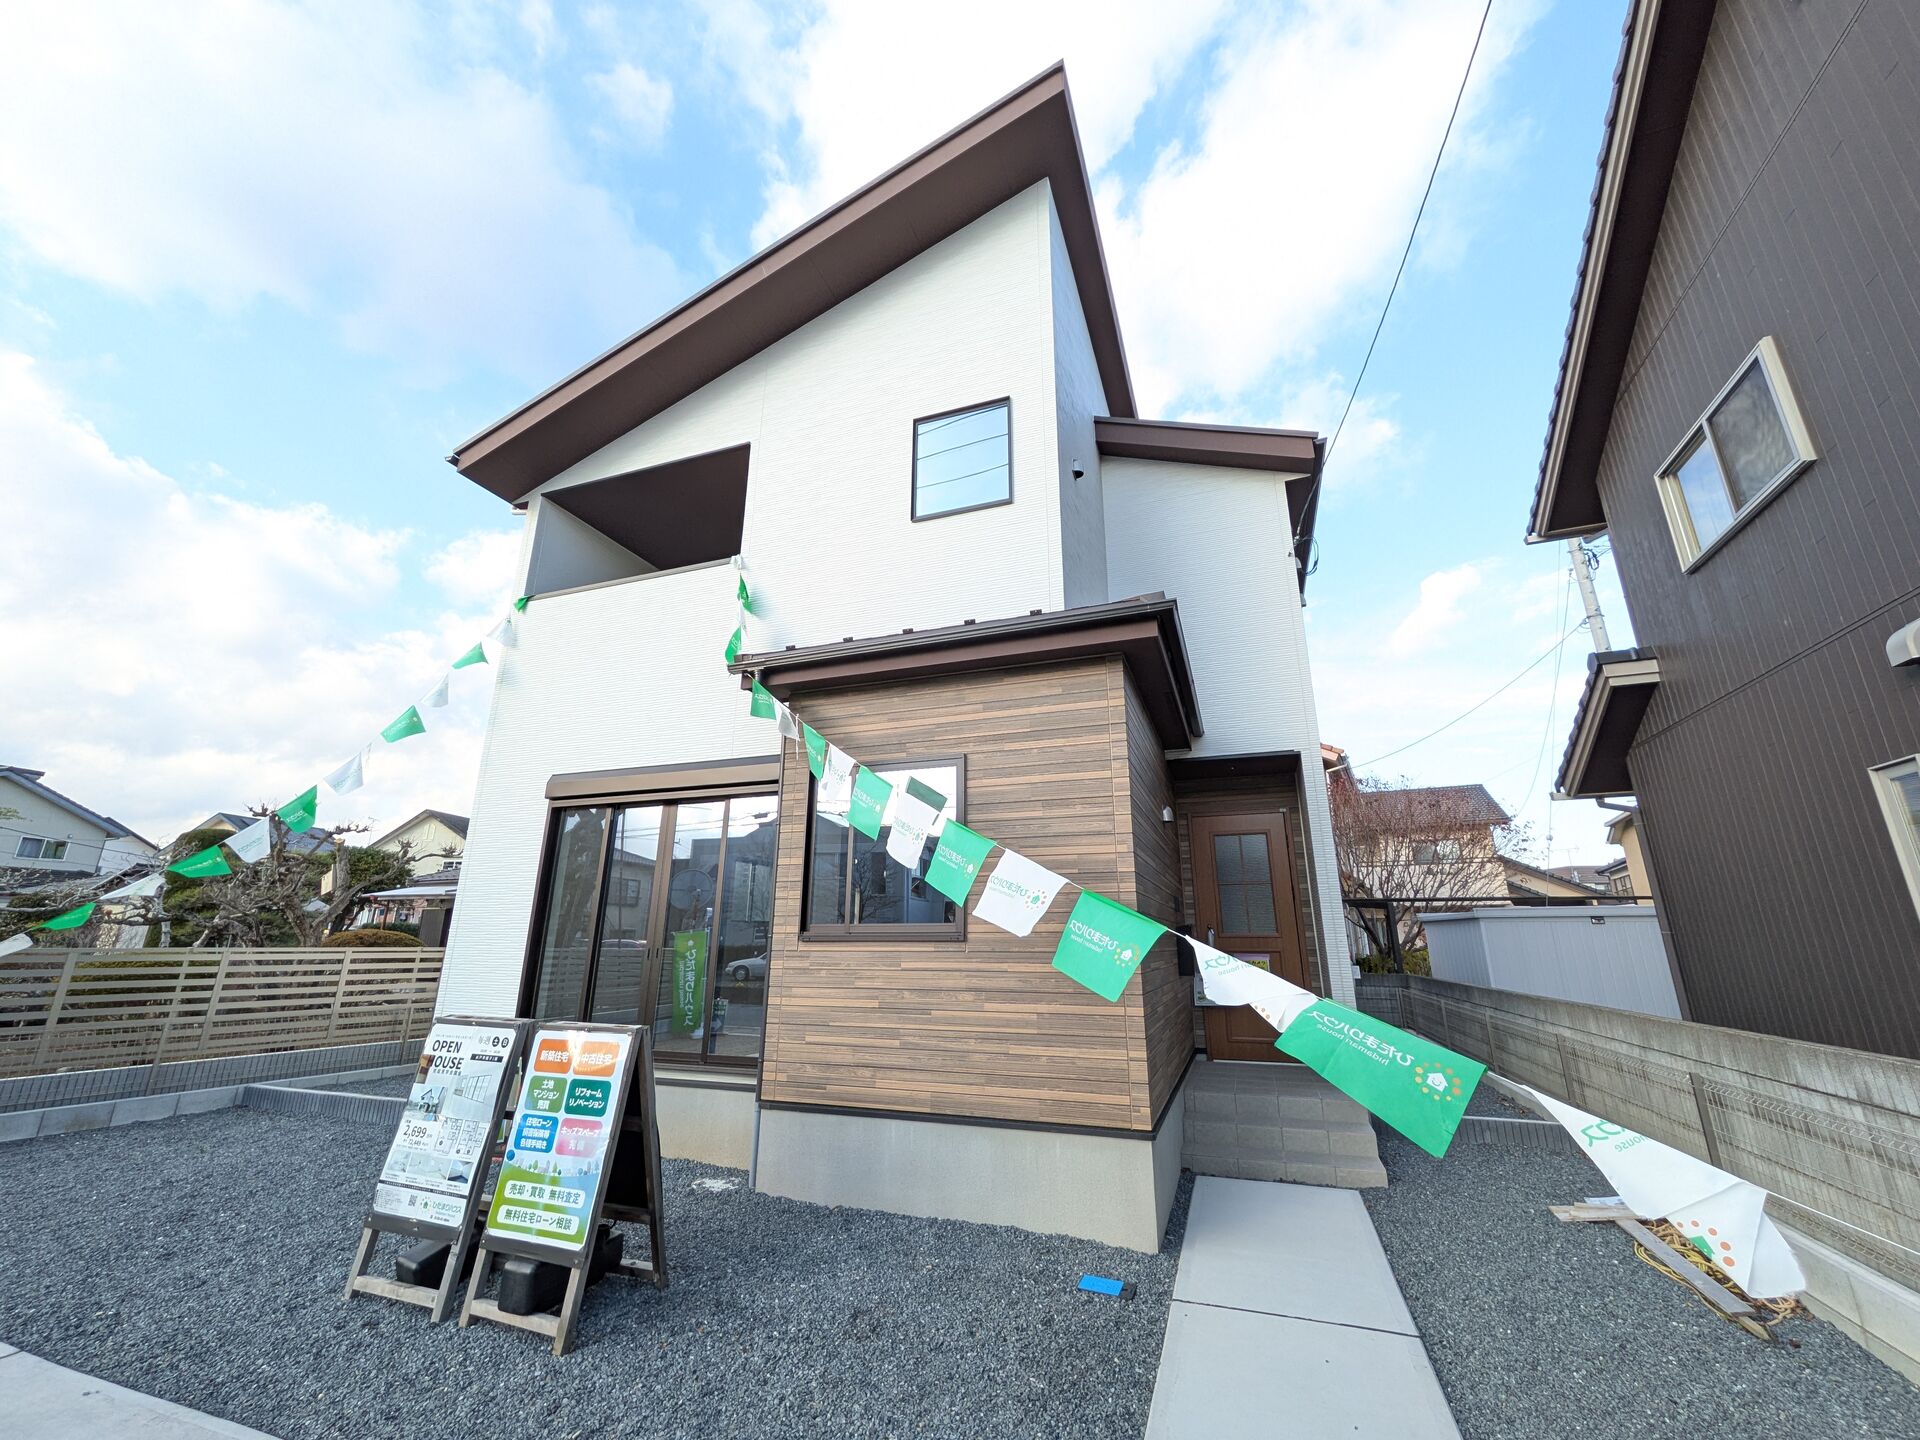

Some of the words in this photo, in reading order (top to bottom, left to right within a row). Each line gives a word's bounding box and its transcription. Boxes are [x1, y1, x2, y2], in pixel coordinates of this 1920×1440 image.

[432, 1040, 462, 1054] OPEN
[540, 1050, 569, 1062] 新築住宅
[541, 1080, 554, 1089] 土地
[533, 1089, 559, 1099] マンション
[575, 1087, 602, 1098] リフォーム
[569, 1098, 604, 1109] リノベーション
[526, 1116, 552, 1128] 住宅ローン
[403, 1124, 428, 1138] 2,699
[548, 1188, 581, 1205] 無料査定
[503, 1208, 573, 1231] 無料住宅ローン相談
